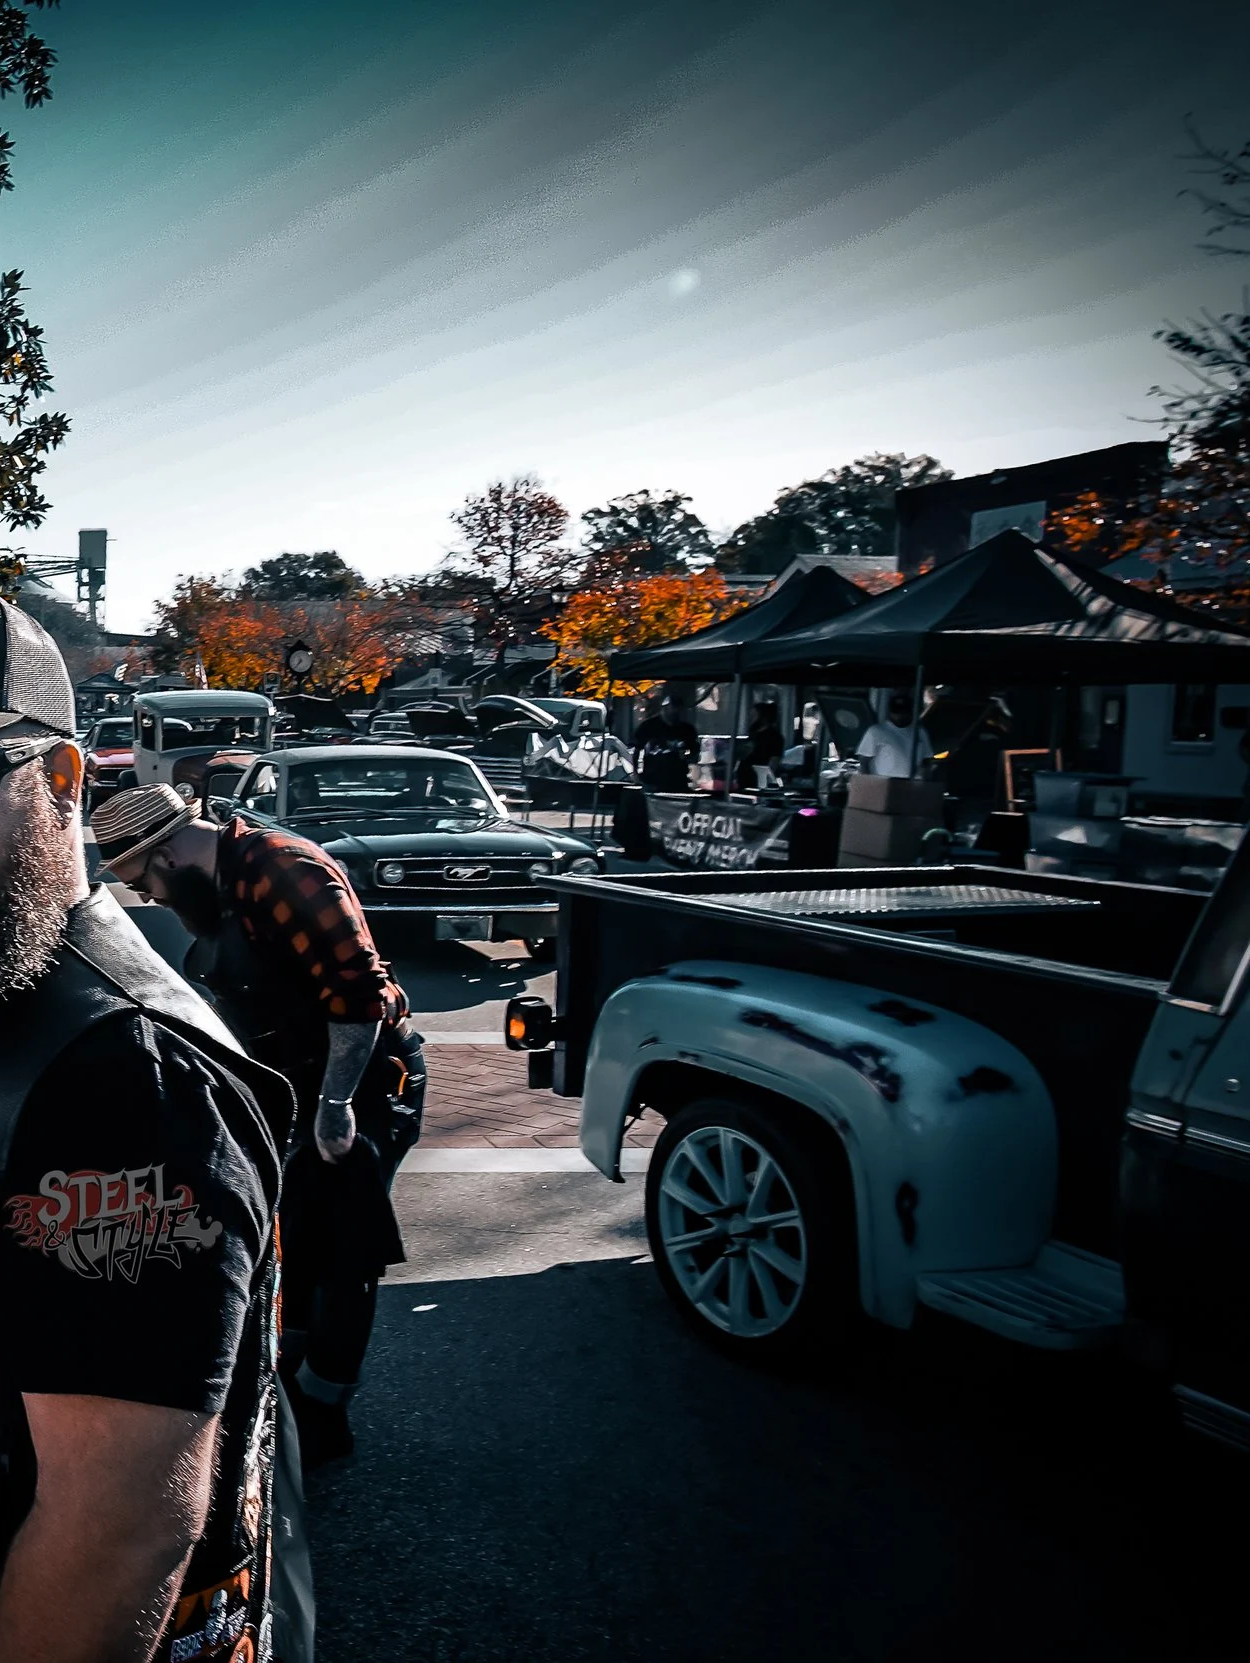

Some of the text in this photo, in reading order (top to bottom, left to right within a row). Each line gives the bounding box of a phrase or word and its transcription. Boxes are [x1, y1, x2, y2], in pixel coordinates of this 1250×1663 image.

[37, 1162, 186, 1227] STEEL
[44, 1201, 201, 1285] & STYLE
